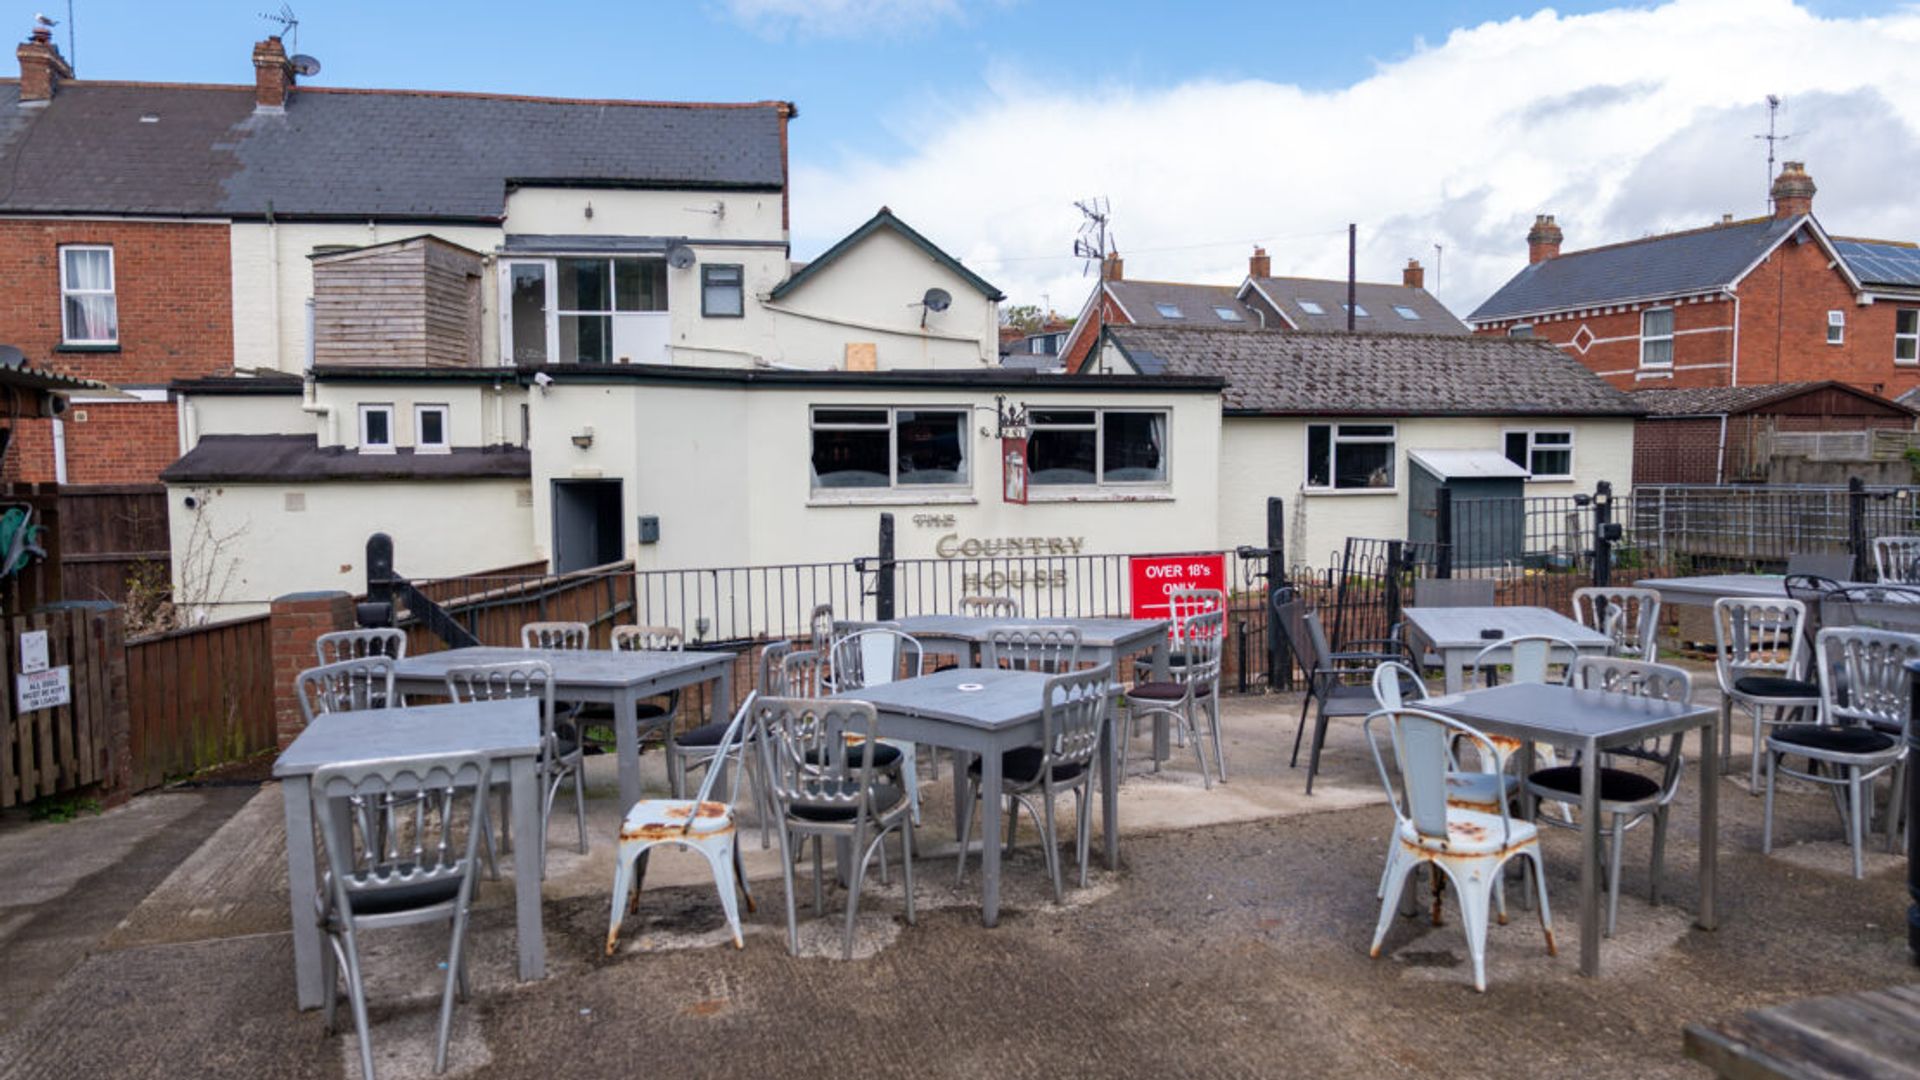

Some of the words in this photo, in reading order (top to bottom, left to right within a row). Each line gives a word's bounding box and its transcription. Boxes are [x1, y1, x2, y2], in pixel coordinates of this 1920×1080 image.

[936, 533, 1084, 558] COUNTRY
[962, 569, 1068, 592] HOUSE
[1145, 565, 1183, 579] OVER
[1187, 564, 1211, 577] 18's
